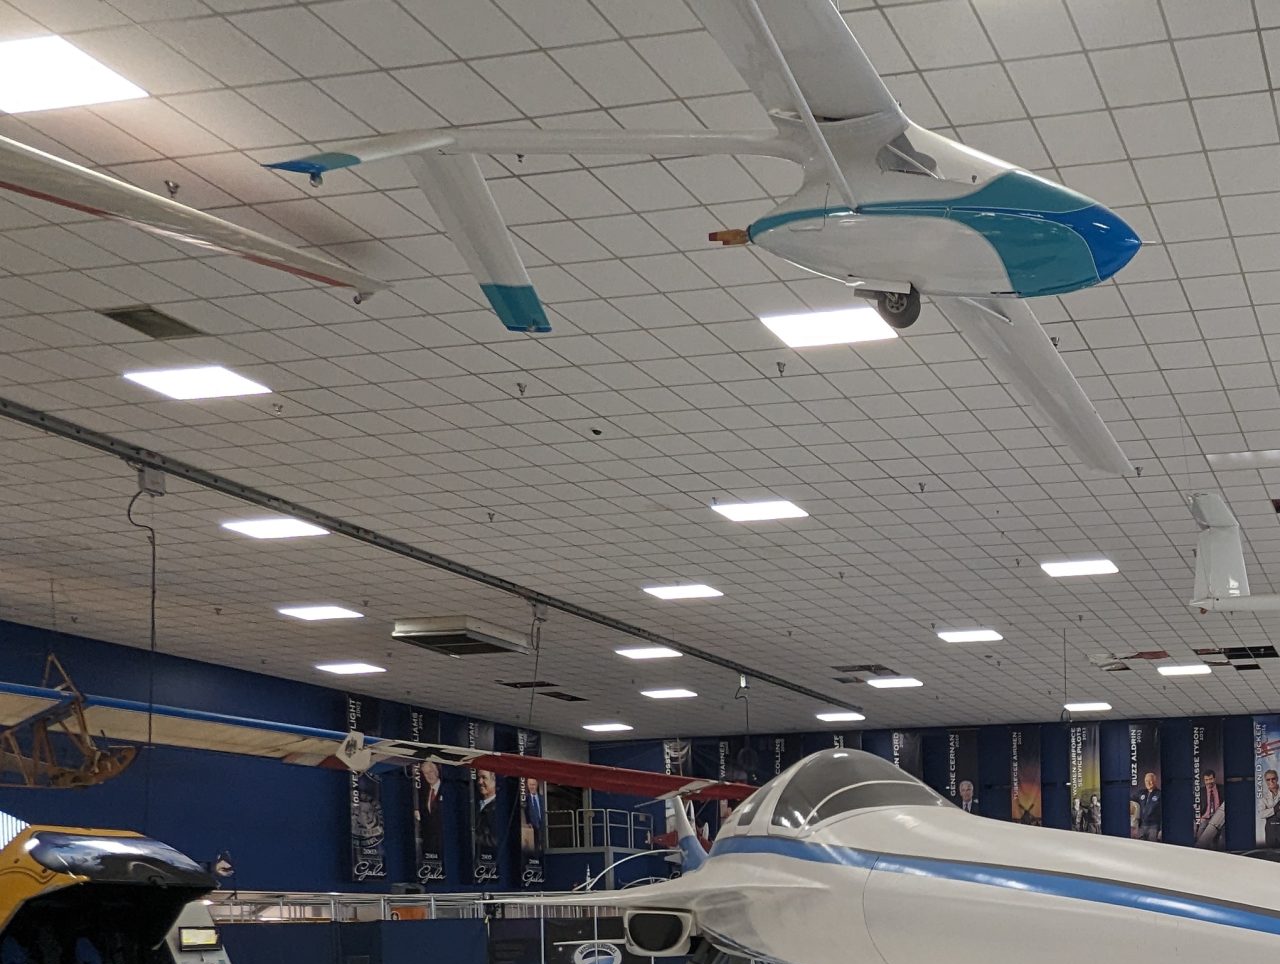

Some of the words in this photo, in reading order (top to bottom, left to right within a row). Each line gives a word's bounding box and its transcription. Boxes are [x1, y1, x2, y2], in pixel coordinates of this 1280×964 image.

[352, 790, 360, 807] 100
[354, 861, 387, 881] Gala
[418, 865, 447, 884] Gala
[474, 865, 500, 884] Gala
[522, 869, 545, 887] Gala
